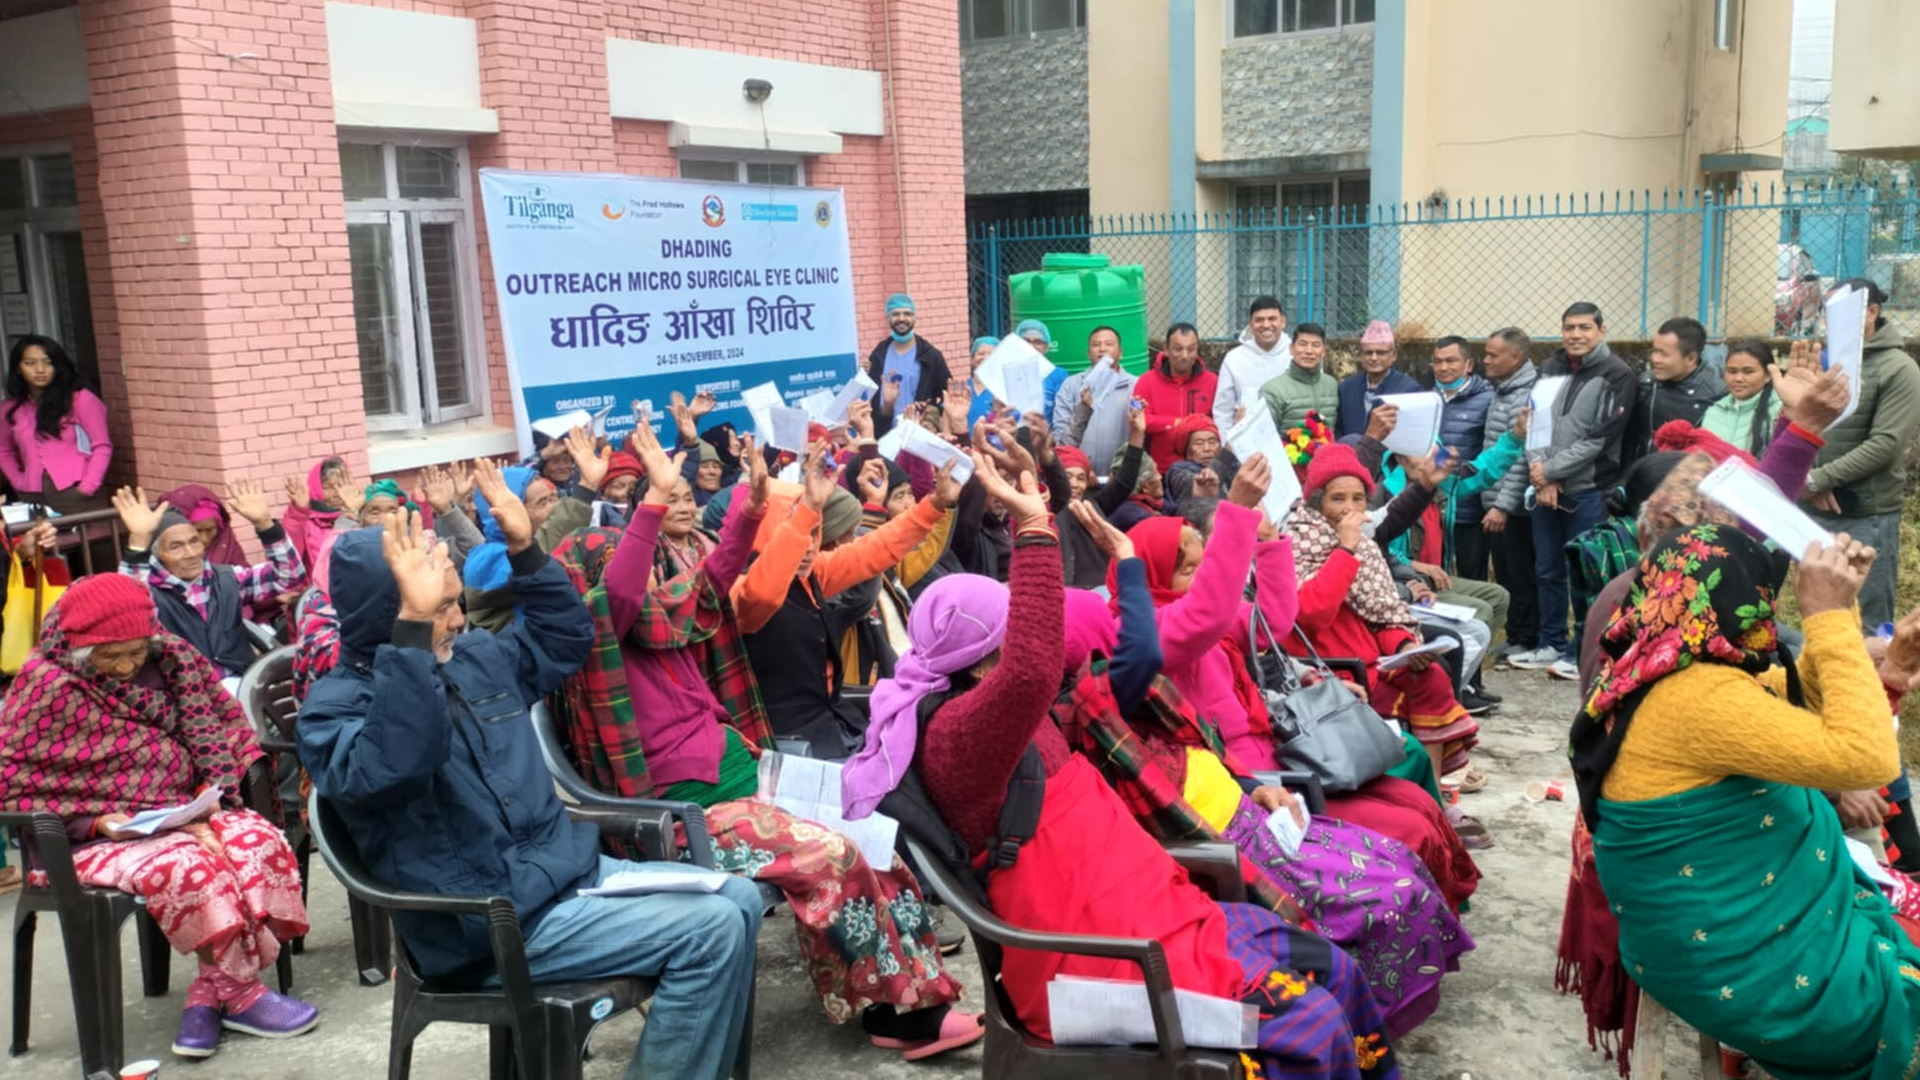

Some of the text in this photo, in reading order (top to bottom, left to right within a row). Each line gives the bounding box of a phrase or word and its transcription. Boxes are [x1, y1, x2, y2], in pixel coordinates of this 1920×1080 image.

[503, 195, 575, 224] Tilganga
[660, 239, 733, 259] DHADING
[505, 267, 840, 296] OUTREACH MICRO SURGICAL EYE CLINIC
[664, 300, 736, 341] आँखा
[746, 295, 816, 335] शिविर
[656, 348, 745, 366] 24-25 NOVEMBER, 2024
[555, 396, 602, 410] ORGANIZED
